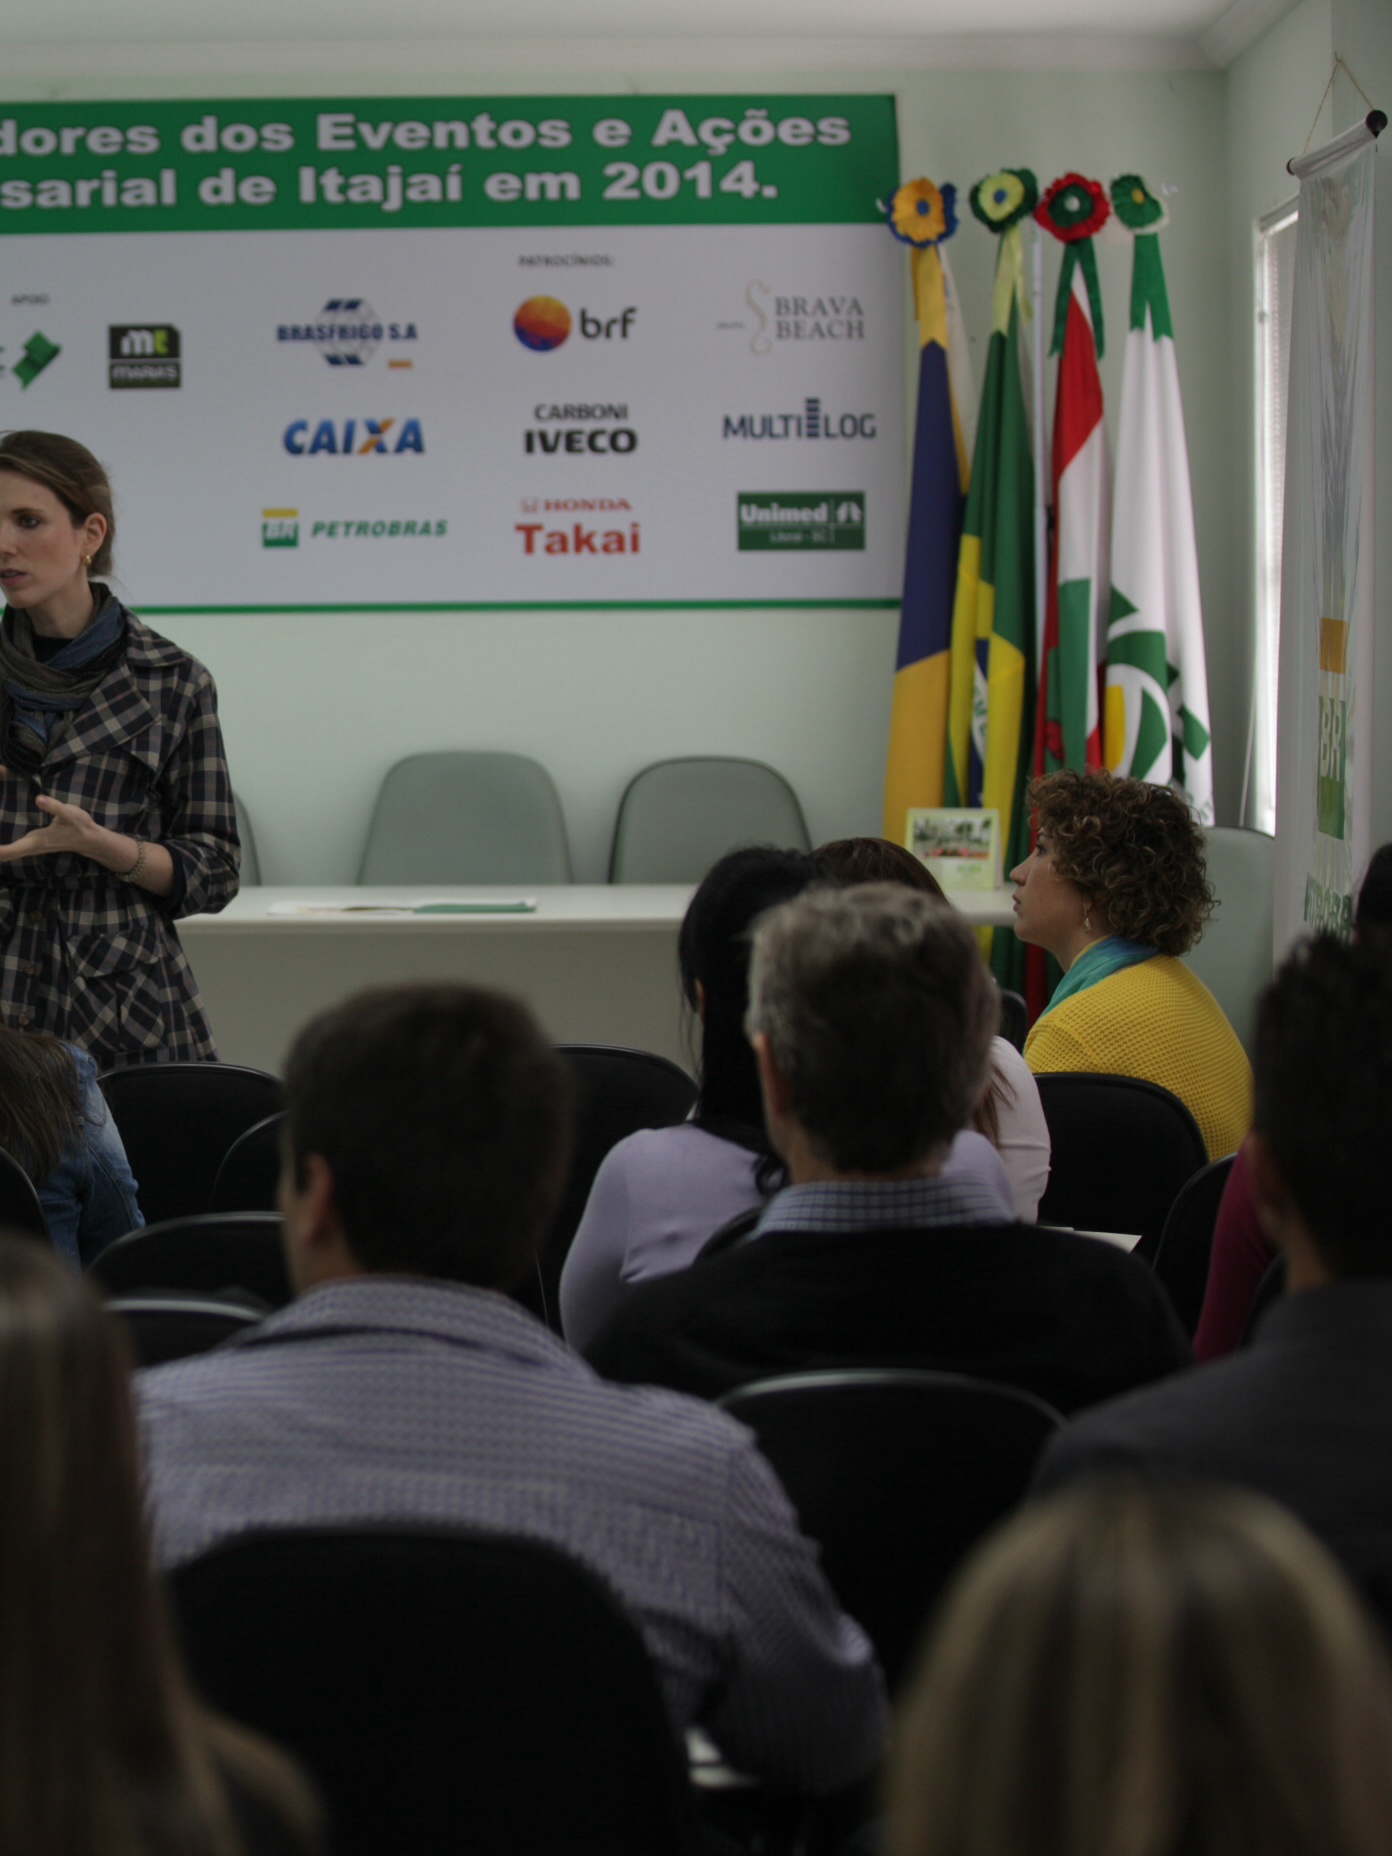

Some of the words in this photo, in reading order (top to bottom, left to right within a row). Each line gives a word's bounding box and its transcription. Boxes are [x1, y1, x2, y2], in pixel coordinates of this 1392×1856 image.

[181, 115, 295, 152] dos
[316, 112, 573, 150] Eventos
[592, 118, 632, 148] e
[651, 108, 852, 155] Ações
[198, 167, 277, 204] de
[299, 163, 462, 212] Itajaí
[484, 169, 581, 200] em
[602, 160, 779, 200] 2014.
[774, 296, 865, 317] BRAVA
[276, 323, 383, 341] BRASFRIGO
[580, 307, 637, 340] brf
[775, 320, 865, 340] BEACH
[534, 403, 629, 421] CARBONI
[283, 418, 426, 456] CAIXA
[524, 428, 638, 455] IVECO
[543, 498, 632, 513] HONDA
[740, 501, 828, 523] Unimed
[311, 519, 449, 539] PETROBRAS
[515, 522, 641, 556] Takai
